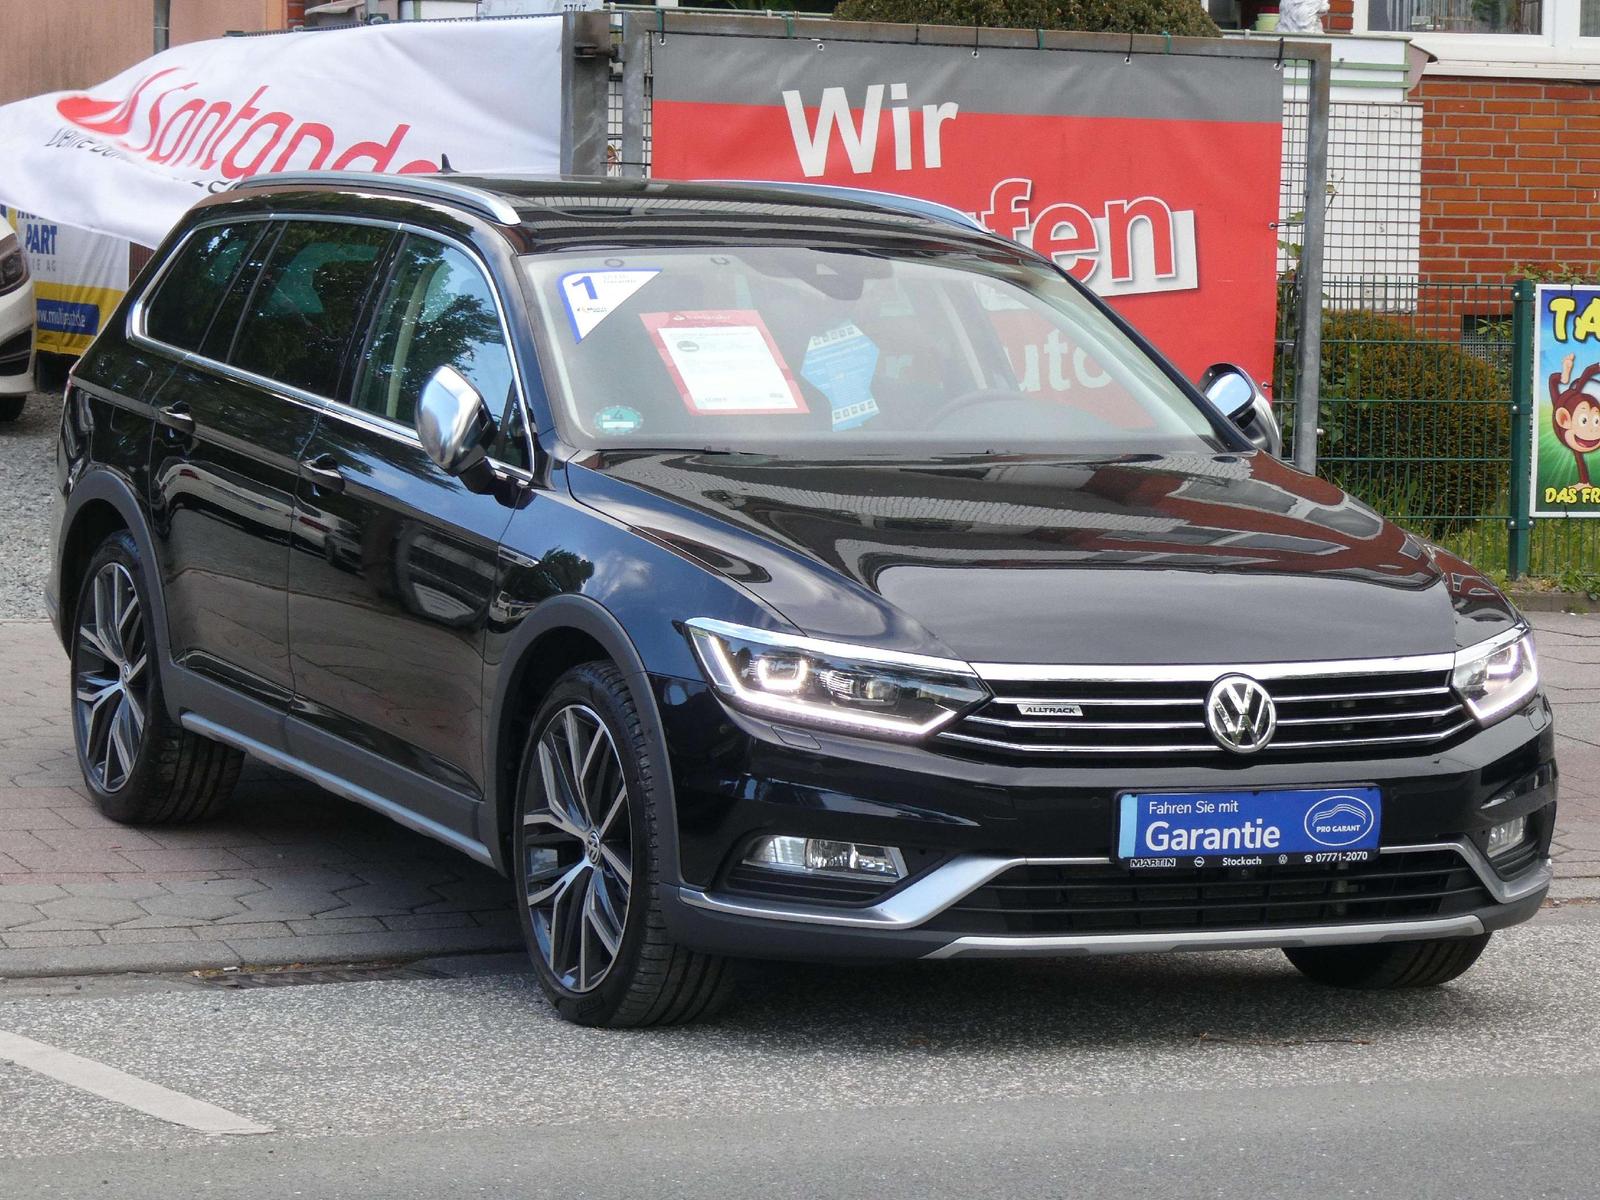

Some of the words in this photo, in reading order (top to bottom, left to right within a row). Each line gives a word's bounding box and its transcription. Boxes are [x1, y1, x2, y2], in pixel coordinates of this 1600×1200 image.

[116, 81, 440, 182] Santand
[782, 82, 959, 178] Wir
[25, 223, 58, 256] PART
[967, 177, 1177, 285] fen
[571, 275, 599, 300] 1
[1003, 330, 1113, 392] uto
[1545, 486, 1578, 504] DAS
[1025, 706, 1076, 714] ALLTRACK
[1148, 801, 1192, 815] Fahren
[1196, 800, 1215, 814] Sie
[1218, 800, 1239, 813] mit
[1145, 817, 1281, 851] Garantie
[1332, 824, 1361, 833] GARANT
[1129, 858, 1177, 868] MARTIN
[1222, 856, 1262, 866] Stockach
[1315, 851, 1368, 863] 07771-2070
